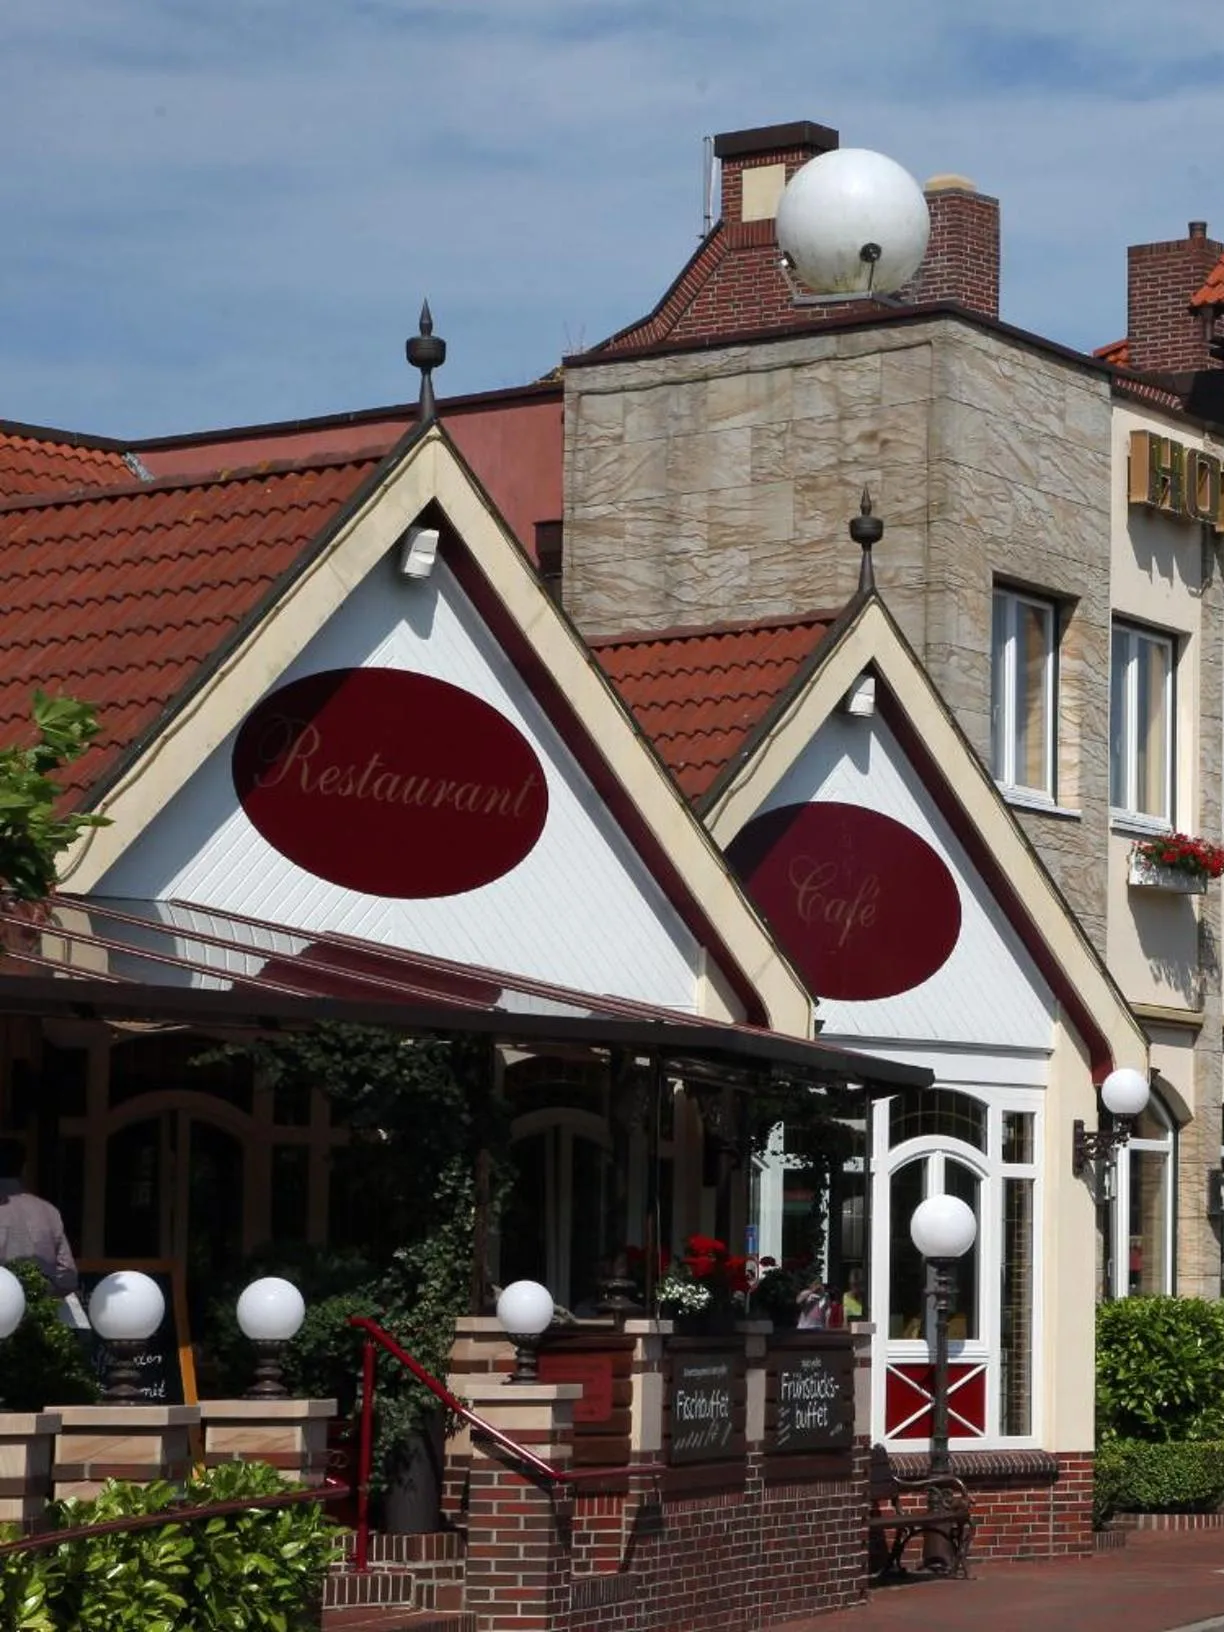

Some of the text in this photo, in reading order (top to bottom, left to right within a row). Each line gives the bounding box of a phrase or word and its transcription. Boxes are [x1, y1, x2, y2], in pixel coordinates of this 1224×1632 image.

[254, 714, 539, 818] Restaurant
[789, 855, 880, 948] Café
[781, 1371, 840, 1401] Frühstücks-
[795, 1401, 829, 1430] buffet
